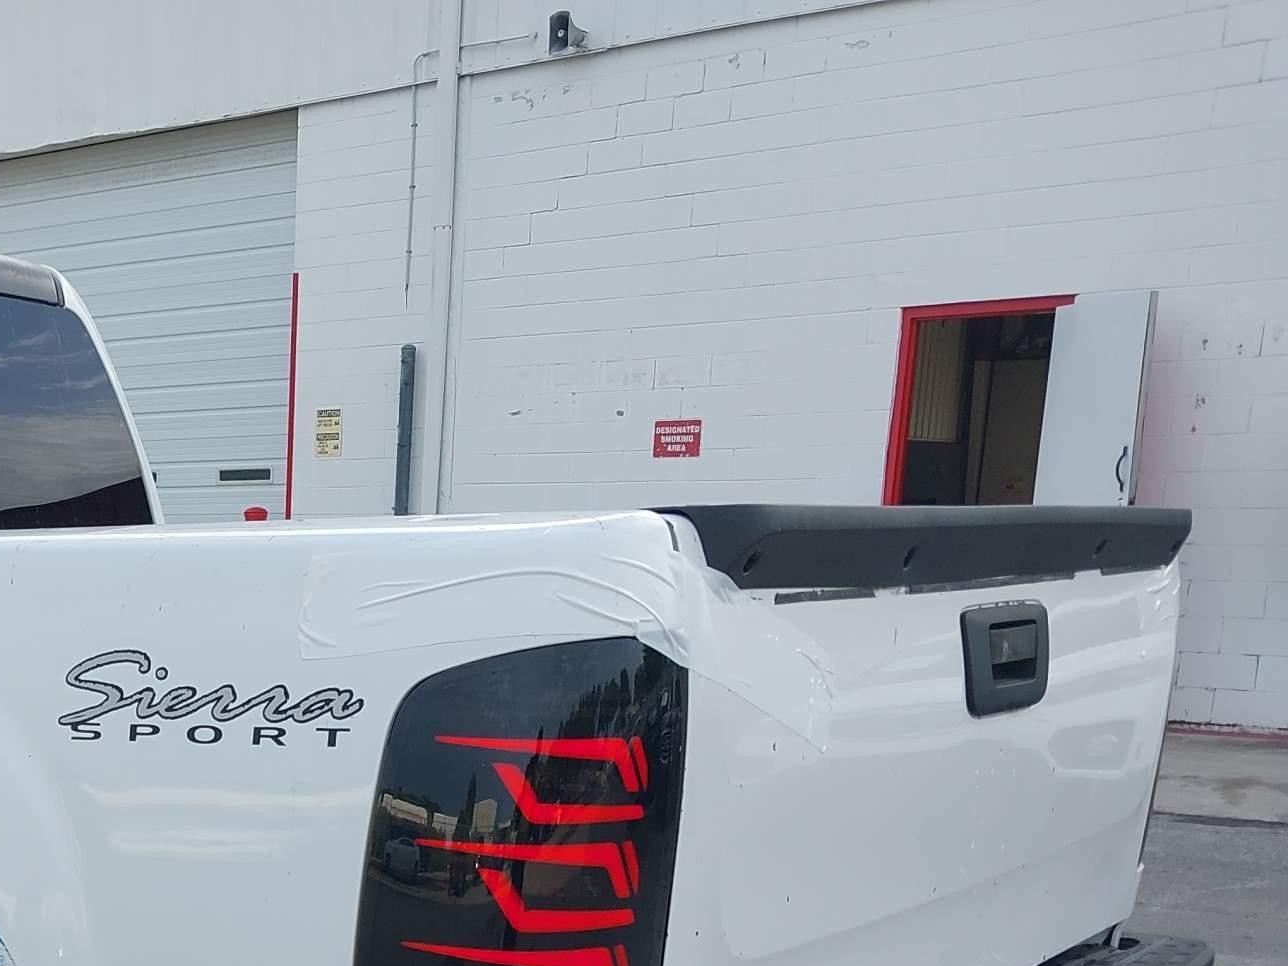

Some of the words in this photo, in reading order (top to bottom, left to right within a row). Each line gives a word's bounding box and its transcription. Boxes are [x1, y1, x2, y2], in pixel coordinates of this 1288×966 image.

[655, 425, 700, 434] DESIGNATED
[660, 435, 694, 443] SMOKING
[666, 444, 686, 452] AREA
[57, 648, 364, 726] Sierra
[70, 722, 351, 748] SPORT
